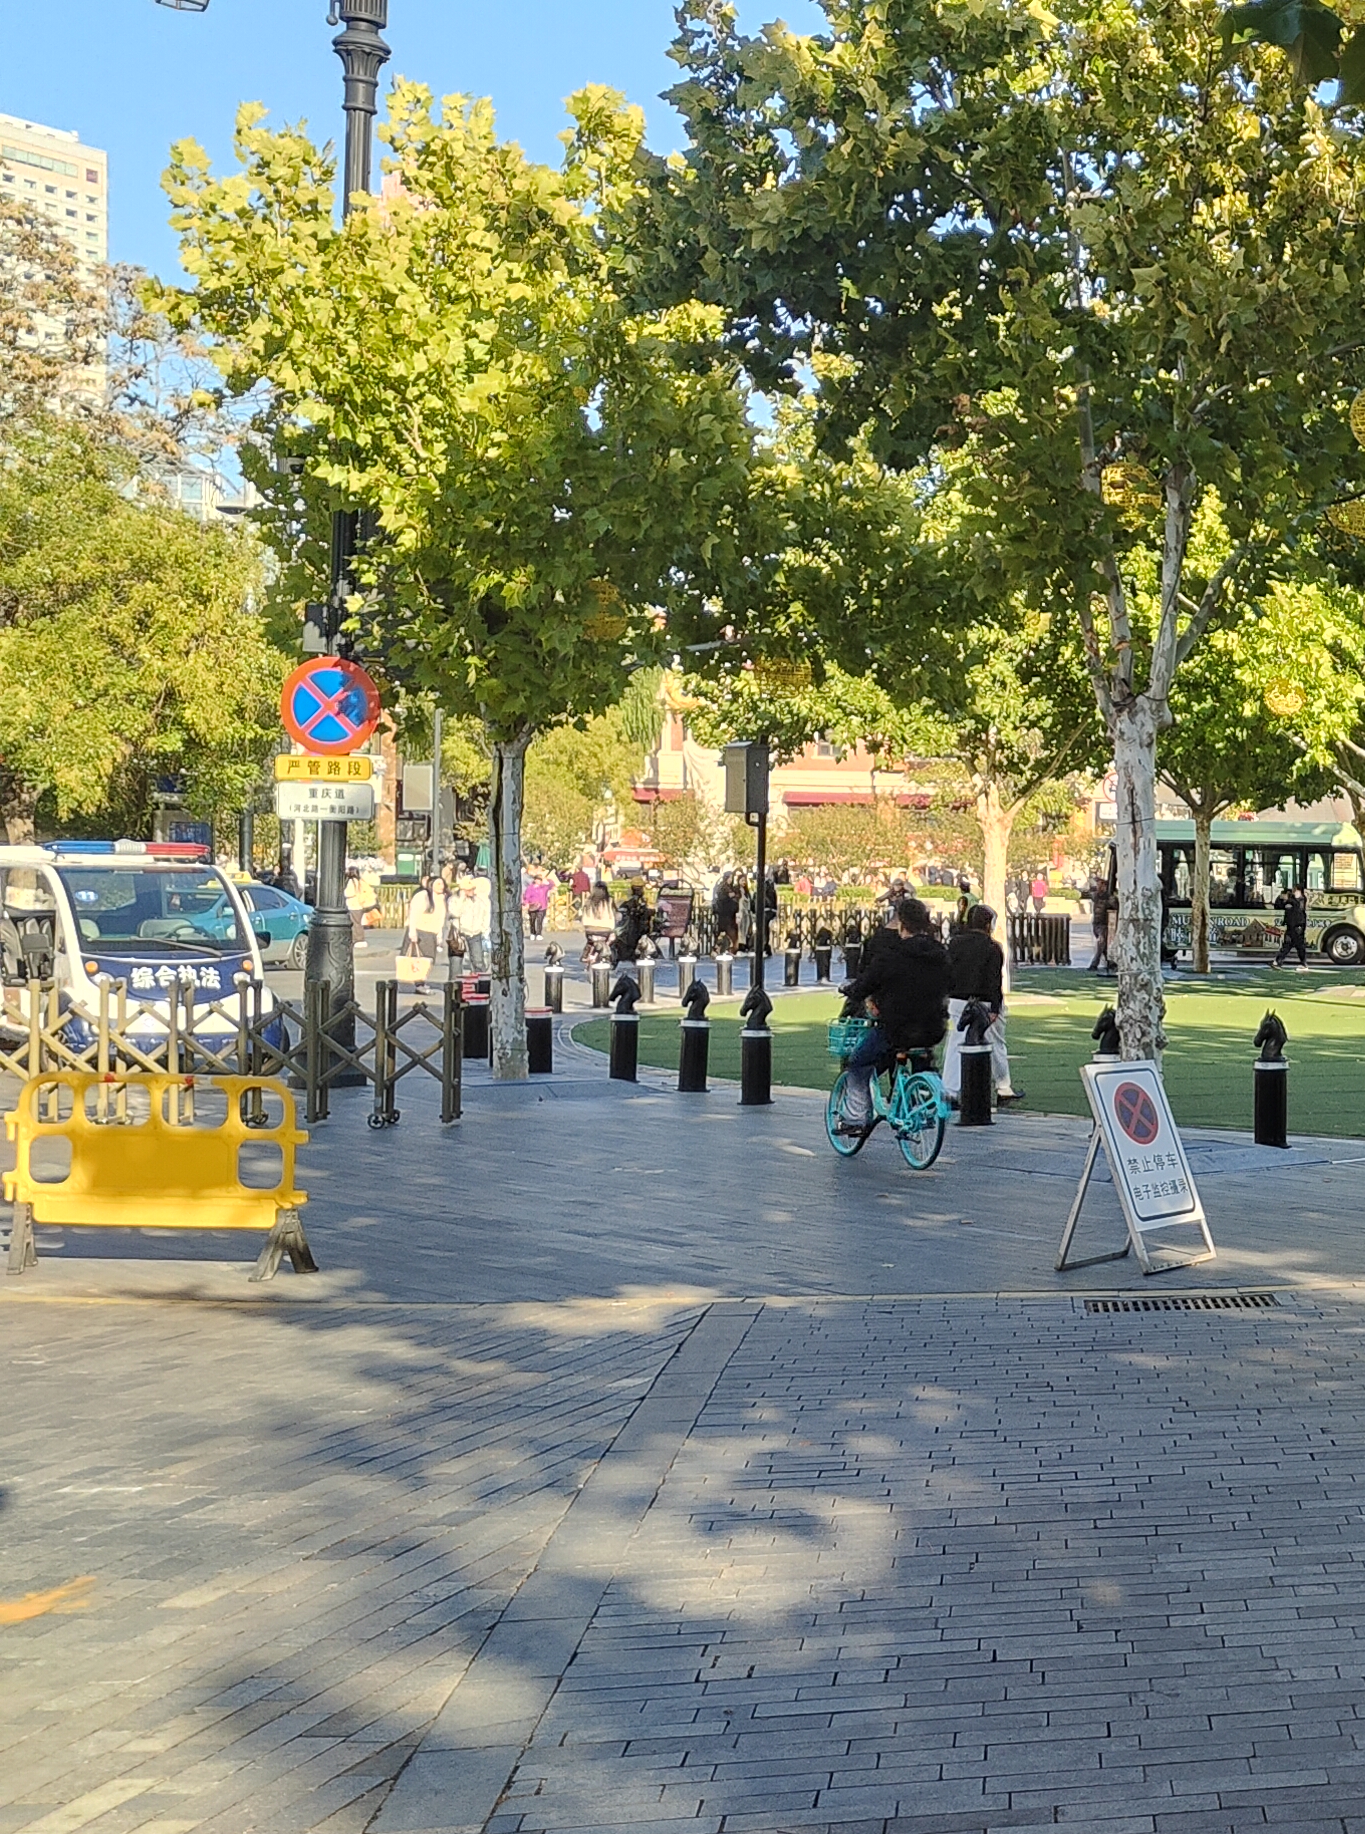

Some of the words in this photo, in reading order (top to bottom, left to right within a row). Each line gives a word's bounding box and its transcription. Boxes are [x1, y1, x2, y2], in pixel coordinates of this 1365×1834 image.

[287, 760, 361, 776] 严管路段
[308, 788, 345, 800] 重庆道
[130, 965, 221, 990] 综合执法
[1126, 1151, 1179, 1175] 禁止停车
